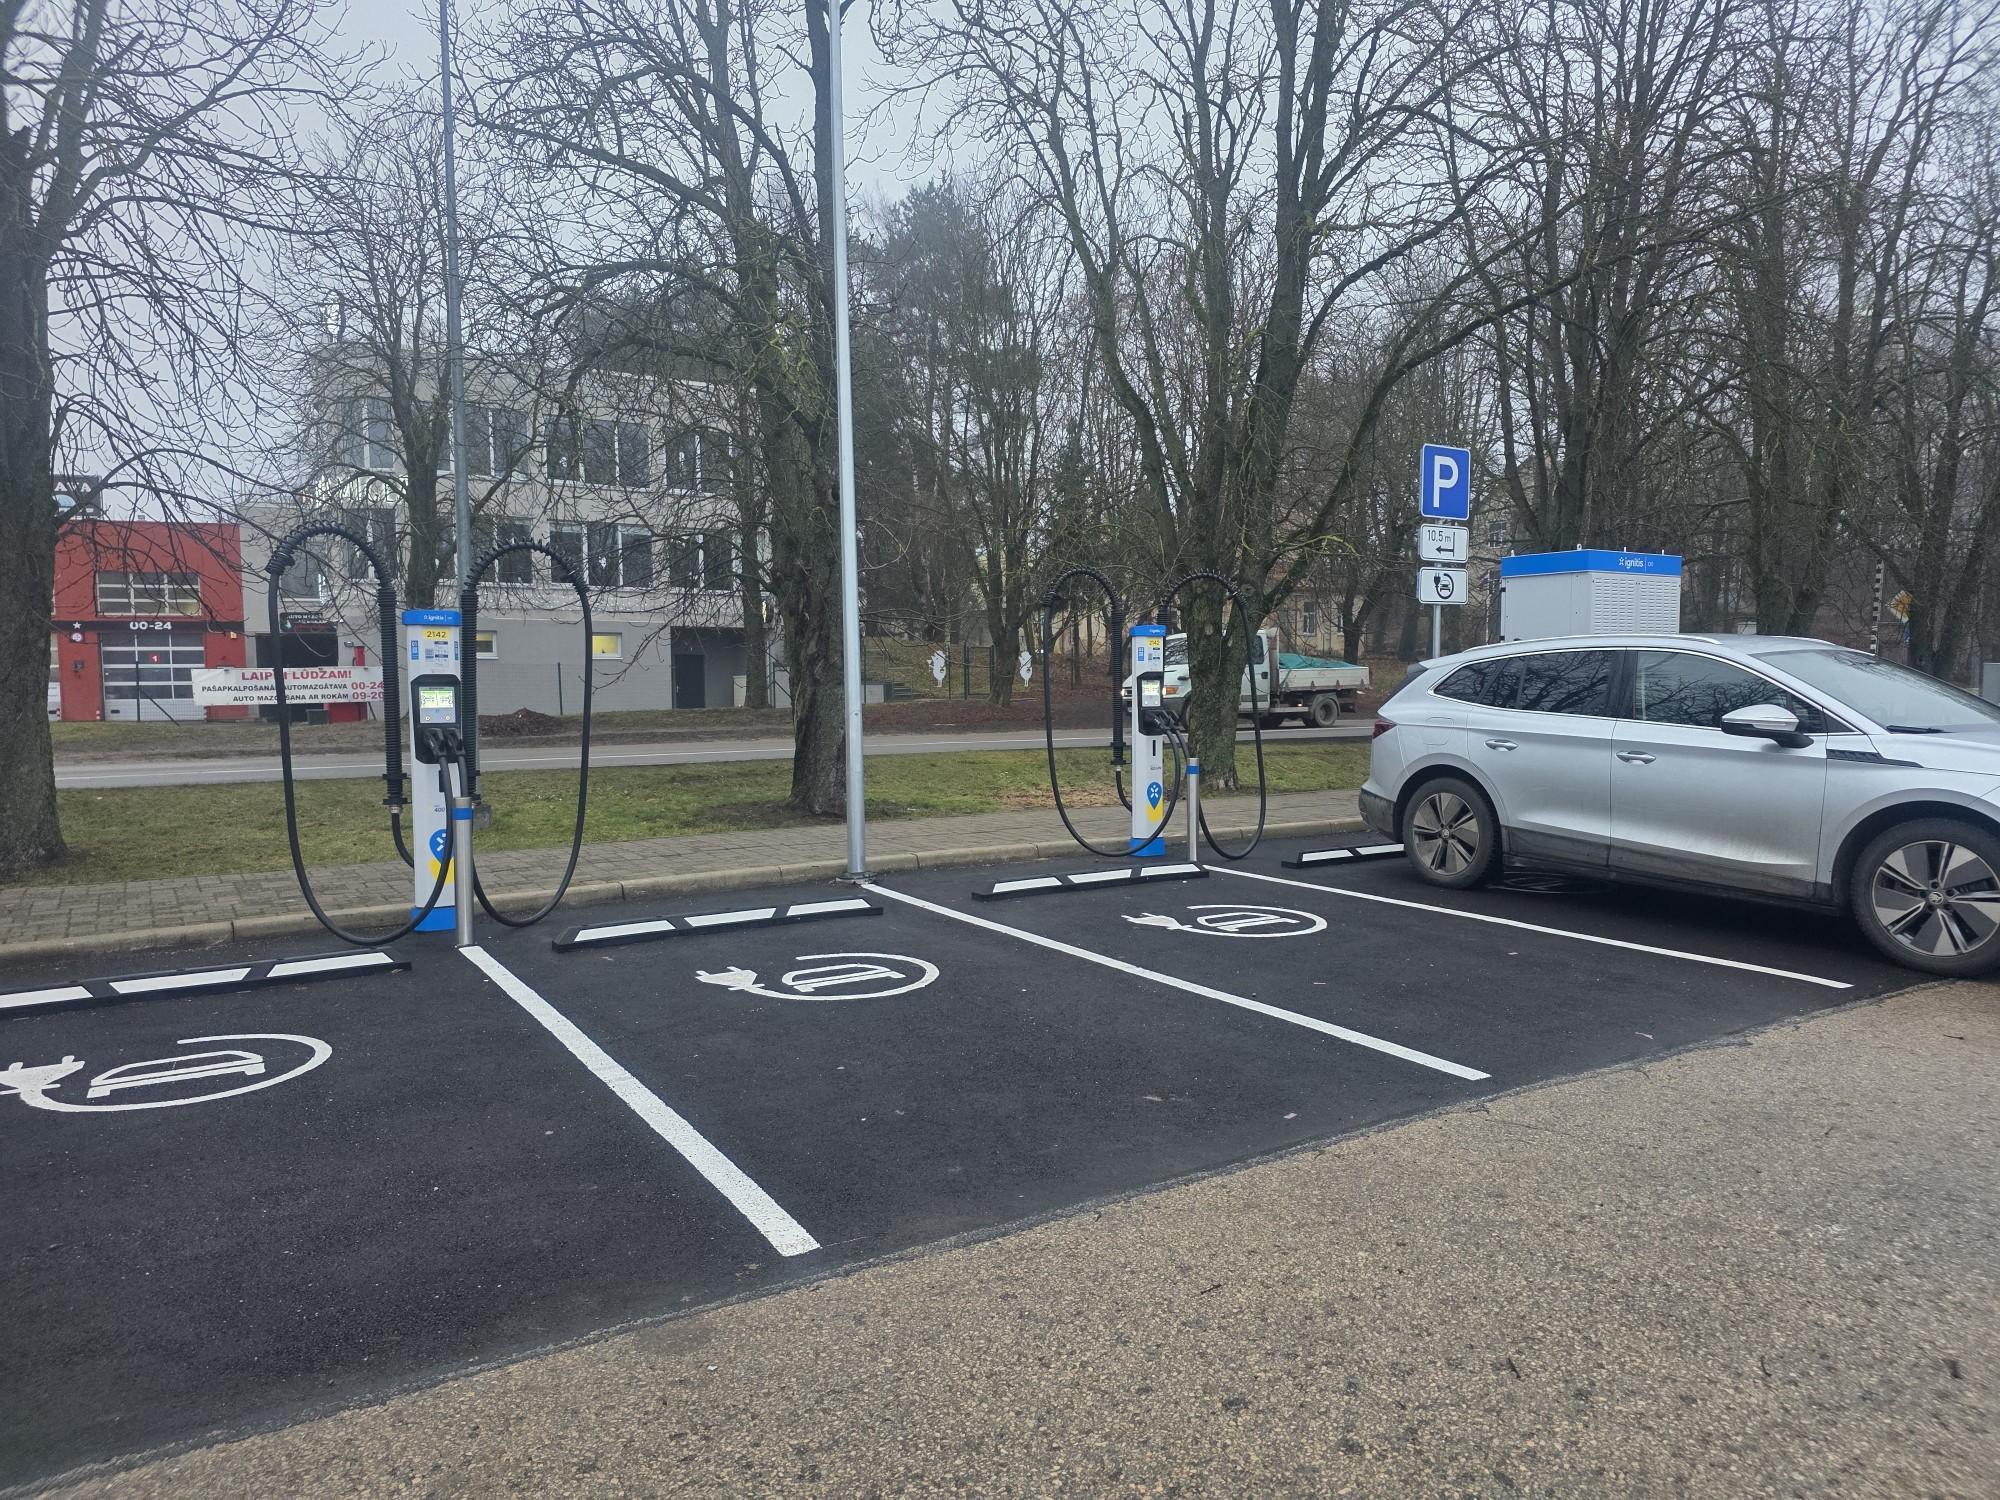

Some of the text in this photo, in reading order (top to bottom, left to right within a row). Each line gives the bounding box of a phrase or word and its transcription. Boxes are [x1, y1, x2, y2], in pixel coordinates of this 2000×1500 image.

[1433, 455, 1459, 508] P
[1624, 556, 1644, 569] ignitis
[129, 621, 172, 630] 00-24
[426, 630, 447, 639] 2142
[241, 671, 288, 681] LAIPI
[201, 684, 275, 692] PAŠAPKALPOŠANĀ
[351, 681, 384, 690] 00-24
[352, 691, 384, 700] 09-20
